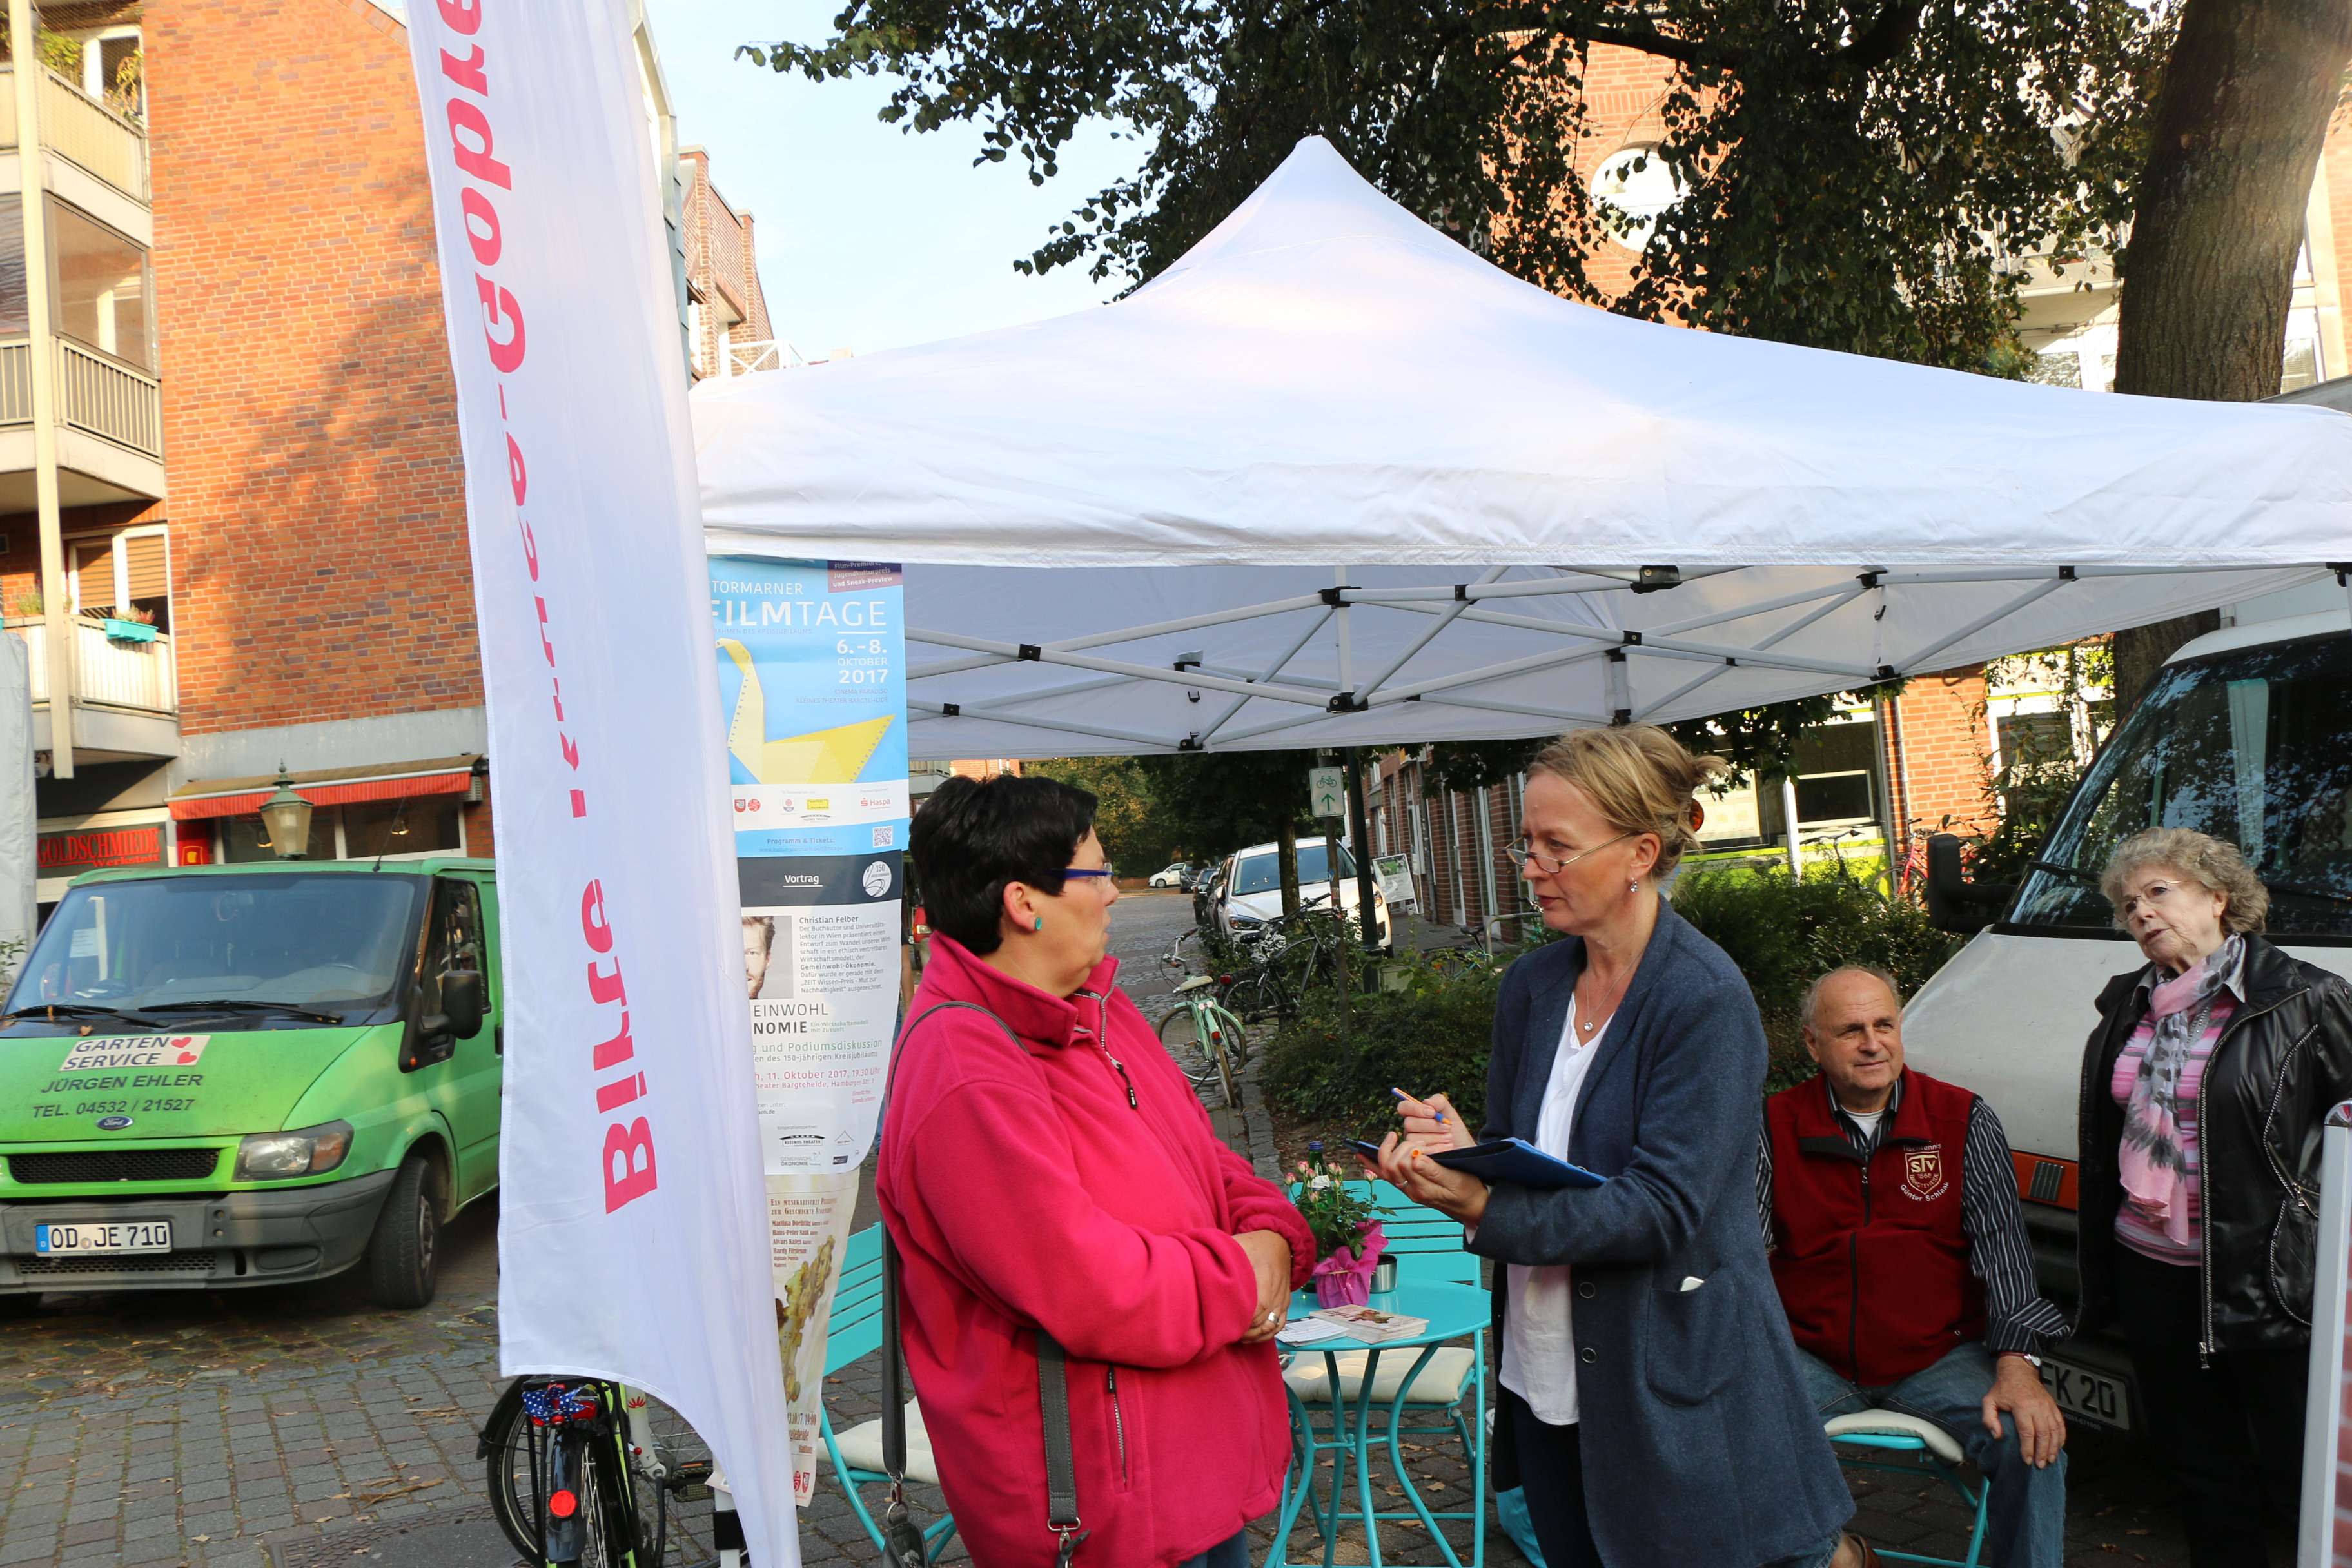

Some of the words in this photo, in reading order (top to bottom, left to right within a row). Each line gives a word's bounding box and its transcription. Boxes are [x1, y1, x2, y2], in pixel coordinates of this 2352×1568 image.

[834, 567, 890, 578] Jugendkulturpreis
[709, 580, 803, 594] TORMARNER
[847, 576, 893, 586] Sneak-Preview
[838, 657, 888, 666] OKTOBER
[839, 669, 888, 683] 2017
[870, 798, 890, 807] Haspa
[37, 828, 160, 864] GOLDSCHMIEDE
[92, 854, 160, 867] Werkstatt
[876, 863, 885, 872] 150
[784, 874, 819, 885] Vortrag
[856, 921, 886, 930] Universitäts-
[800, 961, 876, 970] Gemeinwohl-Ökonomie.
[847, 984, 883, 992] ausgezeichnet.
[753, 1003, 828, 1017] EINWOHL
[753, 1021, 808, 1035] NOMIE
[75, 1037, 170, 1052] GARTEN
[762, 1043, 783, 1052] und
[788, 1038, 883, 1052] Podiumsdiskussion
[63, 1053, 161, 1070] SERVICE
[783, 1053, 832, 1063] 150-jährigen
[834, 1051, 877, 1061] Kreisjubiläums
[783, 1070, 825, 1080] Oktober
[828, 1070, 850, 1079] 2017,
[852, 1068, 868, 1077] 19.30
[870, 1066, 881, 1075] Uhr
[41, 1075, 128, 1093] JÜRGEN
[132, 1075, 203, 1087] EHLER
[782, 1081, 829, 1090] Bargteheide,
[831, 1079, 861, 1088] Hamburger
[34, 1105, 69, 1118] TEL.
[76, 1101, 127, 1115] 04532
[142, 1099, 195, 1112] 21527
[104, 1118, 124, 1127] Ford
[1901, 1184, 1923, 1201] Günter
[1925, 1182, 1949, 1201] Schlank
[51, 1228, 78, 1248] OD
[94, 1227, 121, 1247] JE
[127, 1225, 167, 1246] 710
[2080, 1374, 2116, 1419] 20
